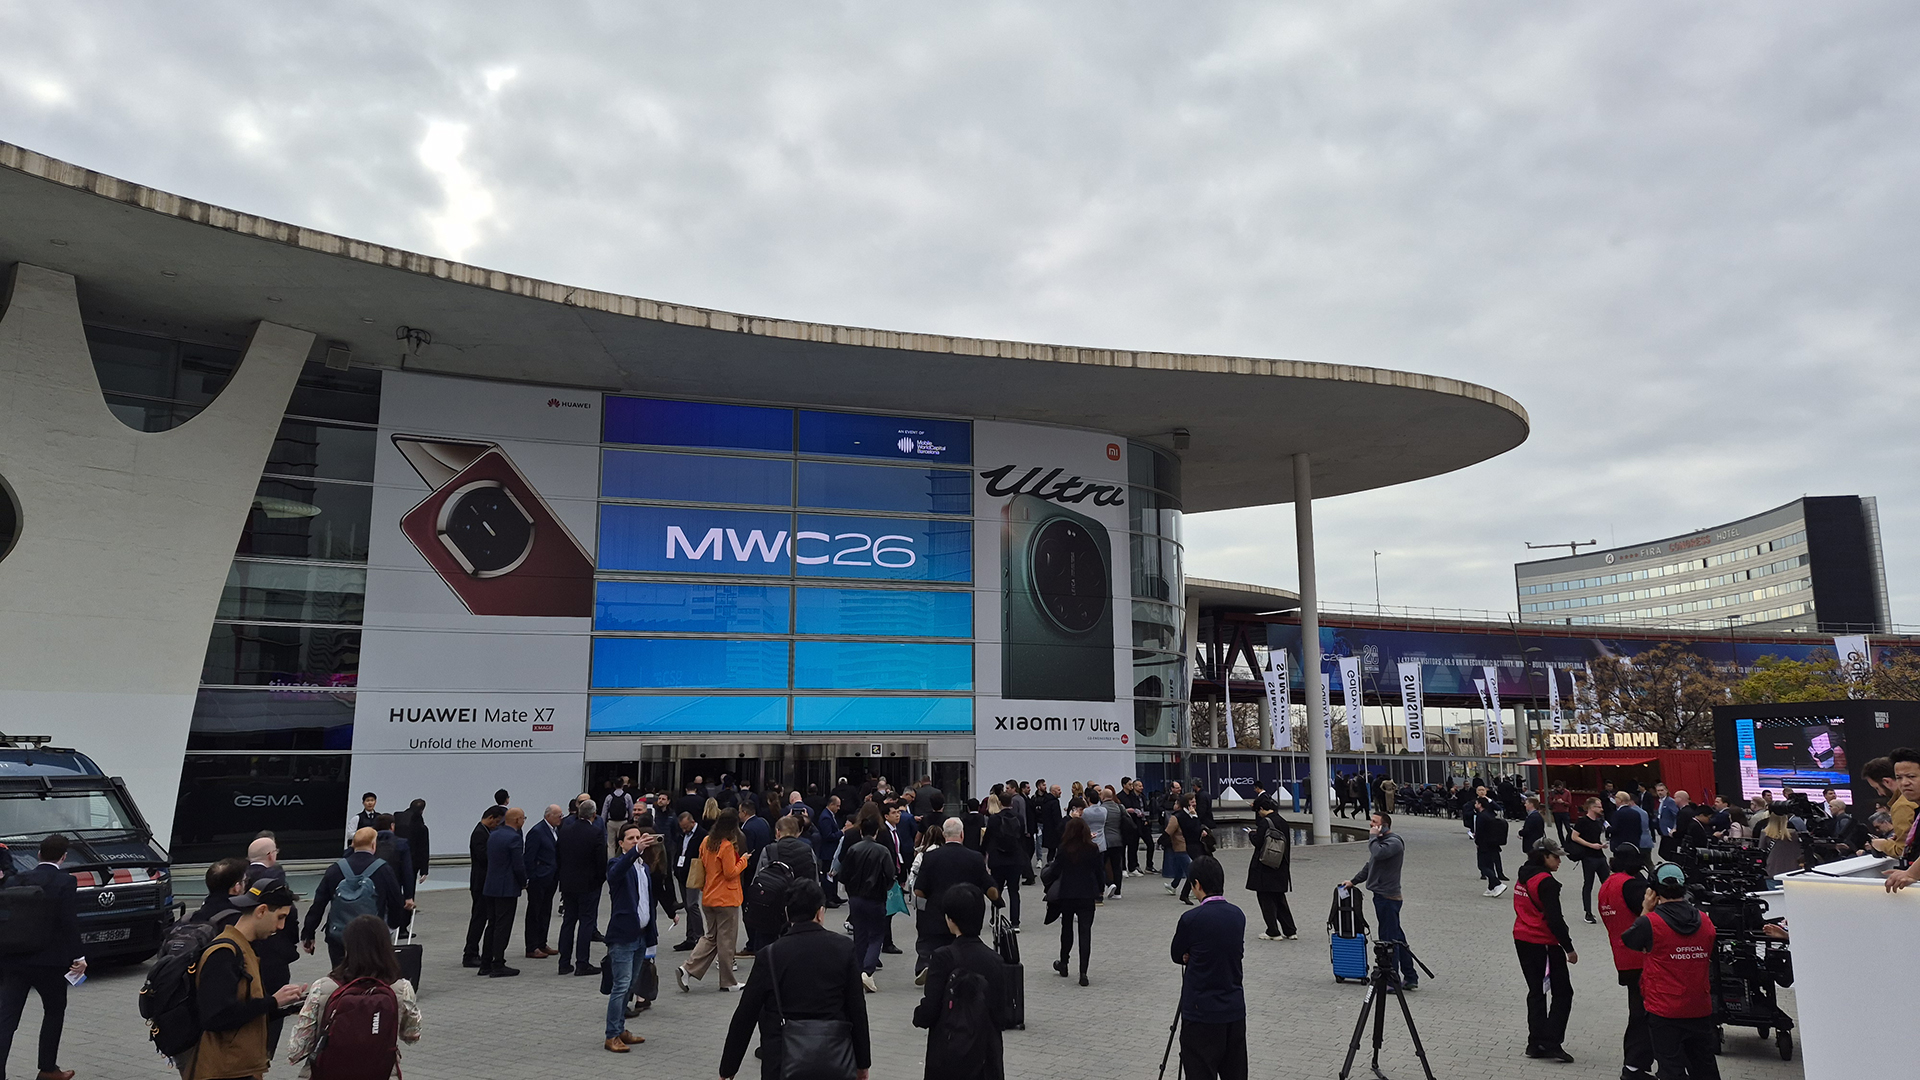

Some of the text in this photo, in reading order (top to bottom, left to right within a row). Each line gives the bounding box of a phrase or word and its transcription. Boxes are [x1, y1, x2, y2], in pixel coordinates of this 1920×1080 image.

[561, 401, 591, 409] HUAWEI
[979, 465, 1125, 507] Ultra
[666, 525, 916, 568] MWC26
[1640, 528, 1741, 557] FIRA CONGRESS HOTEL
[389, 707, 555, 723] HUAWEI Mate X7
[1072, 718, 1085, 731] 17
[1090, 718, 1120, 732] Ultra
[409, 738, 533, 749] Unfold the Moment
[1550, 732, 1659, 748] ESTRELLA DAMM
[1219, 777, 1255, 785] MWC26
[233, 795, 304, 807] GSMA
[1675, 945, 1704, 953] OFFICIAL
[371, 1011, 380, 1035] THULE
